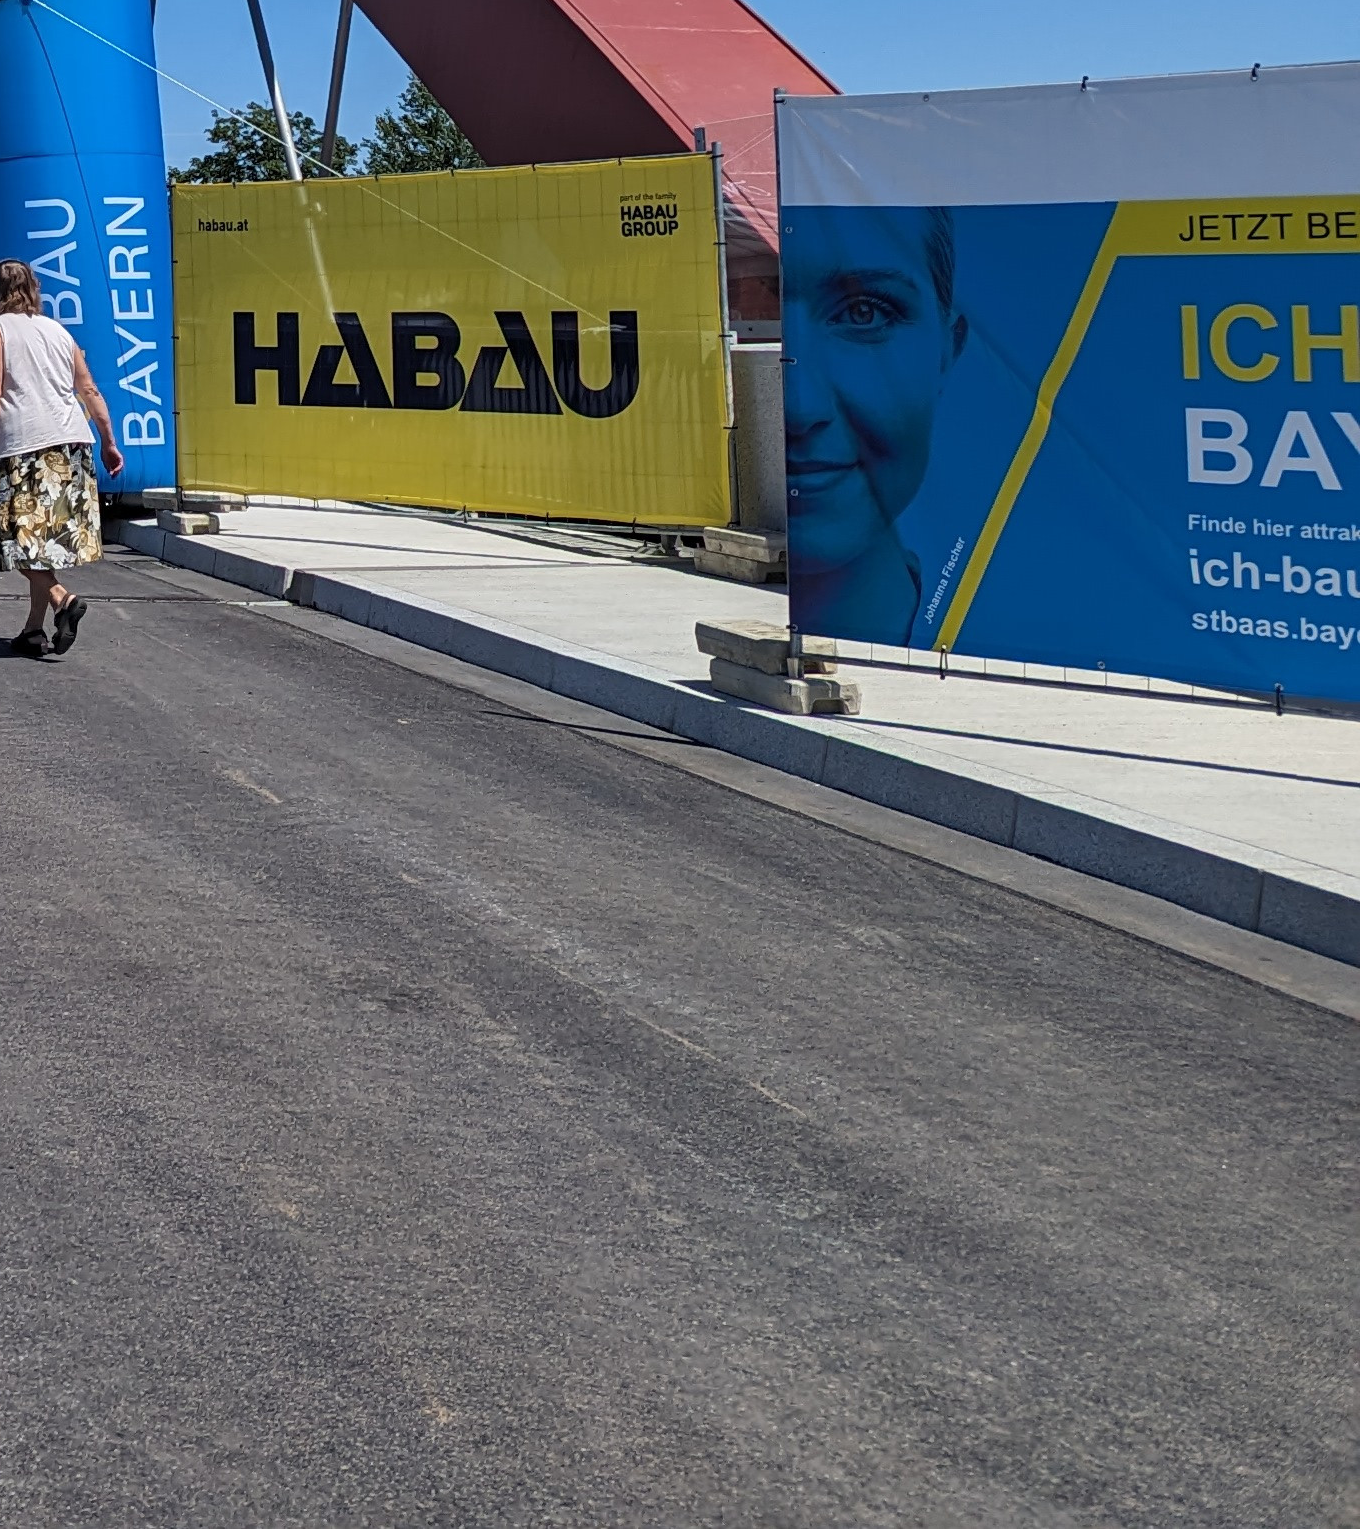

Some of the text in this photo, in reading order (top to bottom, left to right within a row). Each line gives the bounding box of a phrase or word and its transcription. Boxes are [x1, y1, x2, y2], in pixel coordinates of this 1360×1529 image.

[197, 218, 249, 233] habau.at
[620, 203, 678, 222] HABAU
[621, 220, 679, 237] GROUP
[1179, 213, 1293, 242] JETZT
[24, 197, 84, 326] BAU
[103, 196, 166, 447] BAYERN
[1180, 304, 1360, 382] ICH
[233, 310, 640, 419] HABAU
[1188, 513, 1247, 534] Finde
[1253, 518, 1294, 537] hier
[924, 536, 966, 625] Johanna Fischer
[1191, 609, 1360, 650] stbaas.bay
